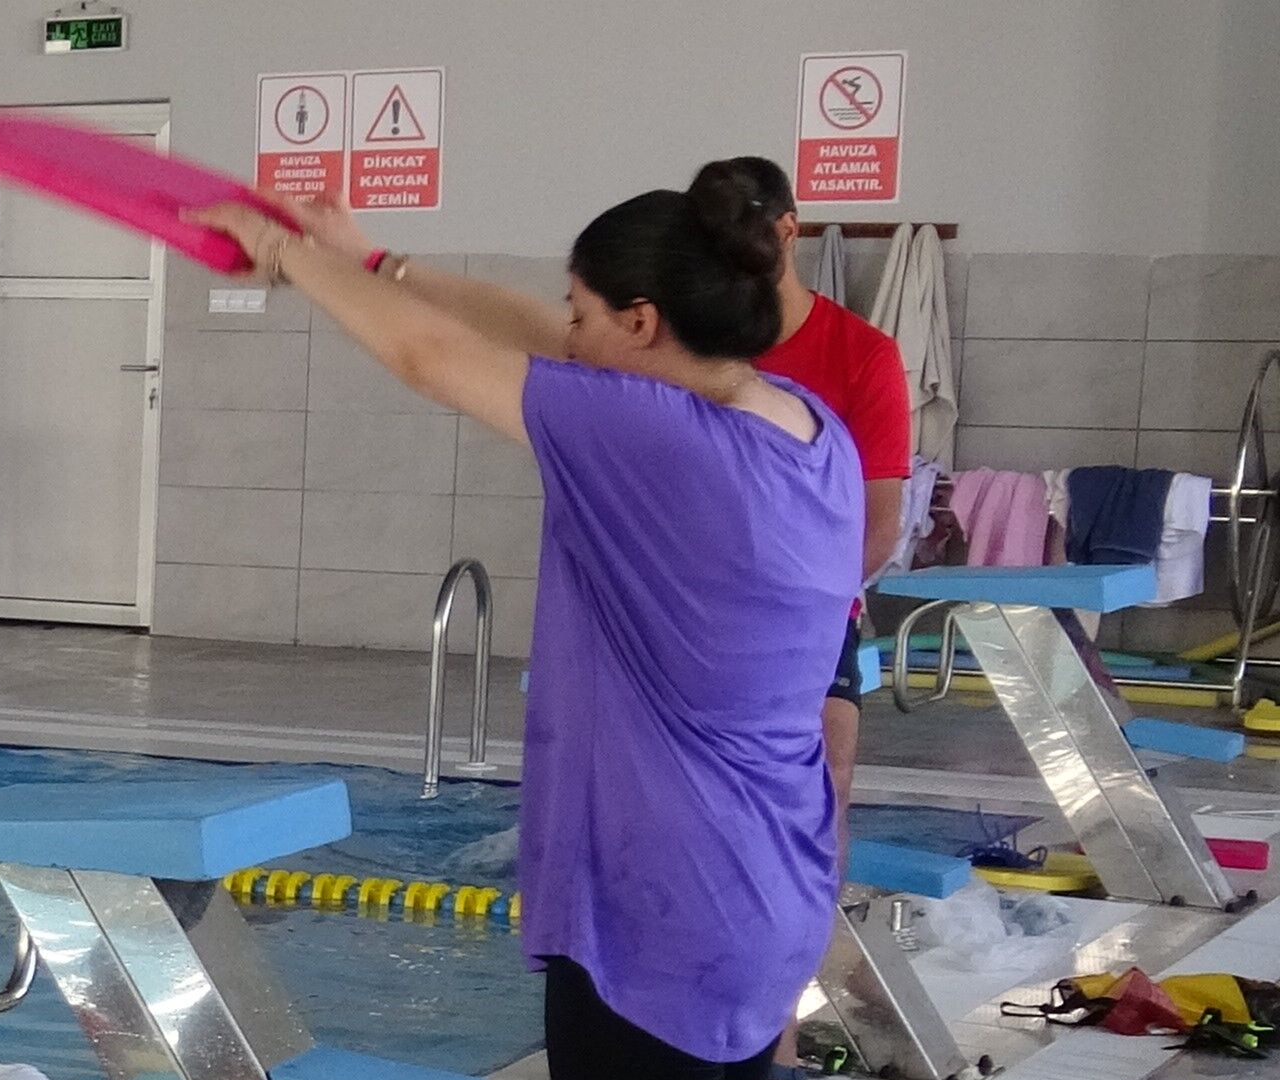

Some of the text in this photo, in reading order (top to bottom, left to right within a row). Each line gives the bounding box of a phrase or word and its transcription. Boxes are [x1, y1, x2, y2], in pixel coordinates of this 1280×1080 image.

[820, 145, 877, 157] HAVUZA
[280, 156, 321, 166] HAVUZA
[364, 155, 426, 167] DİKKAT
[814, 162, 880, 174] ATLAMAK
[360, 174, 428, 187] KAYGAN
[810, 179, 882, 191] YASAKTIR.
[367, 192, 419, 205] ZEMİN
